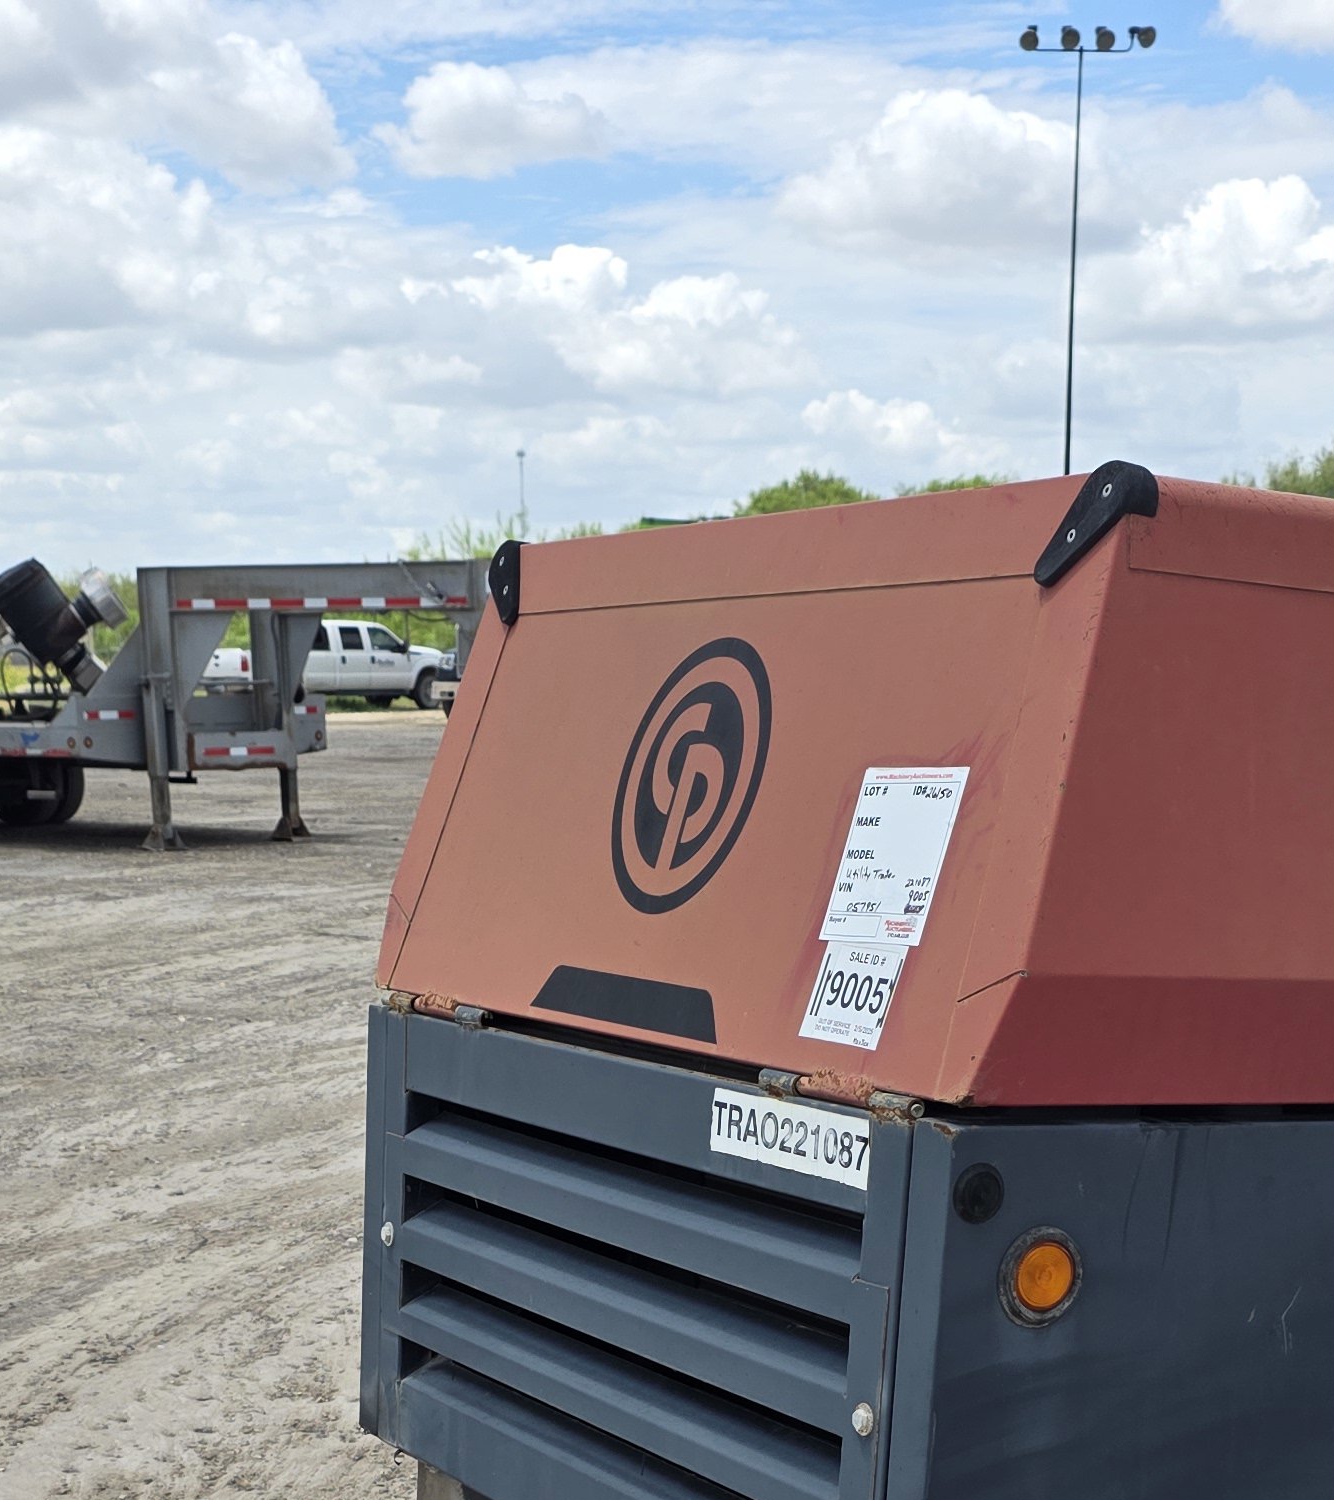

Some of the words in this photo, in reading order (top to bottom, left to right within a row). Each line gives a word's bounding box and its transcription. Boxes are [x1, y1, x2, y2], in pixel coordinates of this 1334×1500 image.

[864, 786, 881, 796] LOT
[882, 786, 888, 796] #
[856, 816, 881, 827] MAKE
[846, 849, 875, 860] MODEL
[838, 882, 853, 892] VIN
[849, 951, 871, 964] SALE
[870, 954, 880, 966] ID
[826, 970, 889, 1014] 9005
